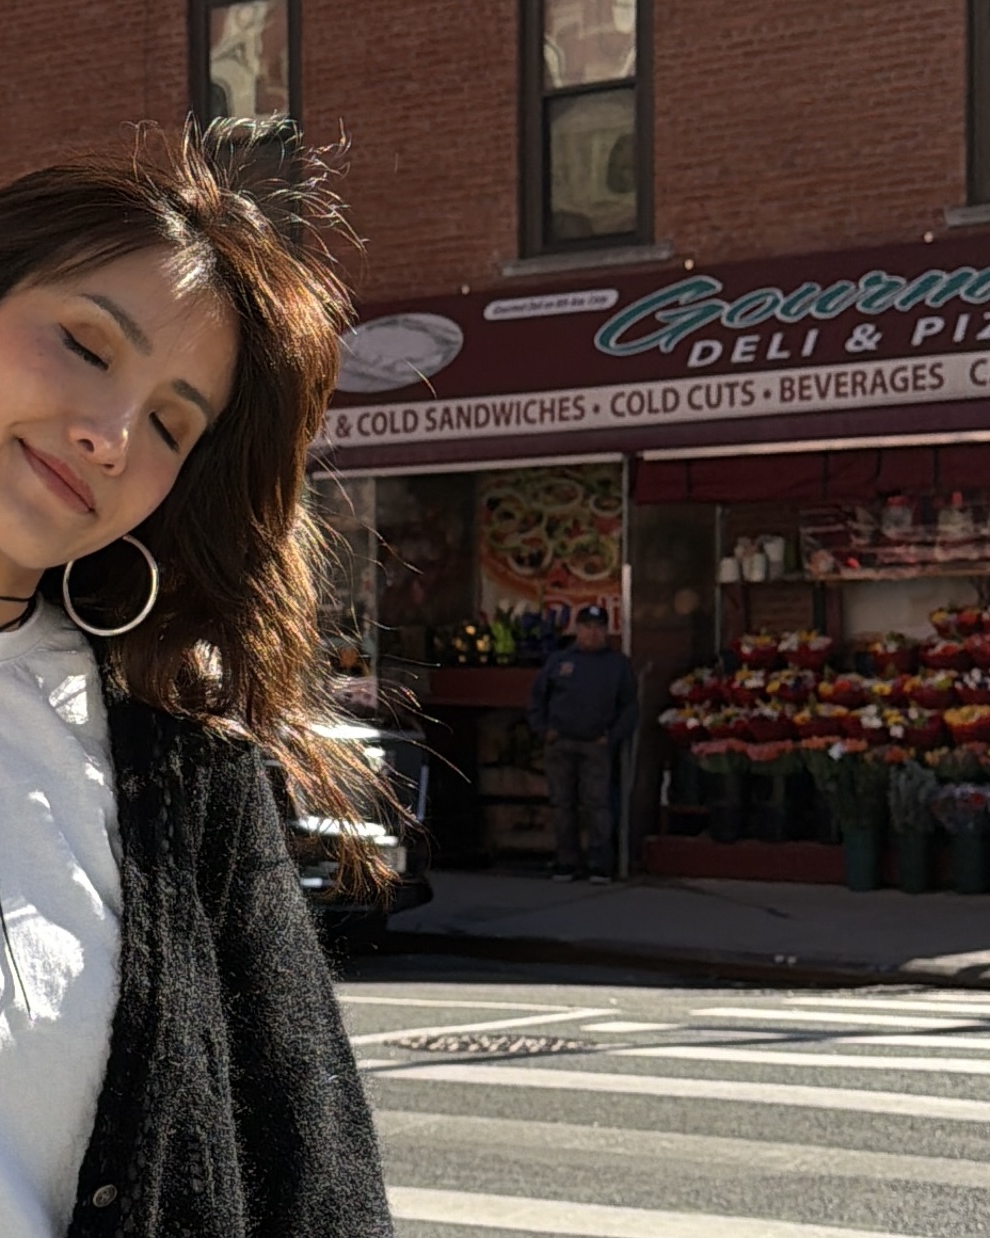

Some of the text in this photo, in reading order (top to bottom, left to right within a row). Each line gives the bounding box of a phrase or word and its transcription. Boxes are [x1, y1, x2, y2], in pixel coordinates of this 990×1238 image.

[687, 328, 820, 368] DELI
[844, 322, 882, 353] &
[335, 414, 353, 438] &
[357, 408, 419, 436] COLD
[425, 395, 586, 433] SANDWICHES
[610, 386, 681, 418] COLD
[687, 380, 756, 410] CUTS
[779, 362, 945, 403] BEVERAGES
